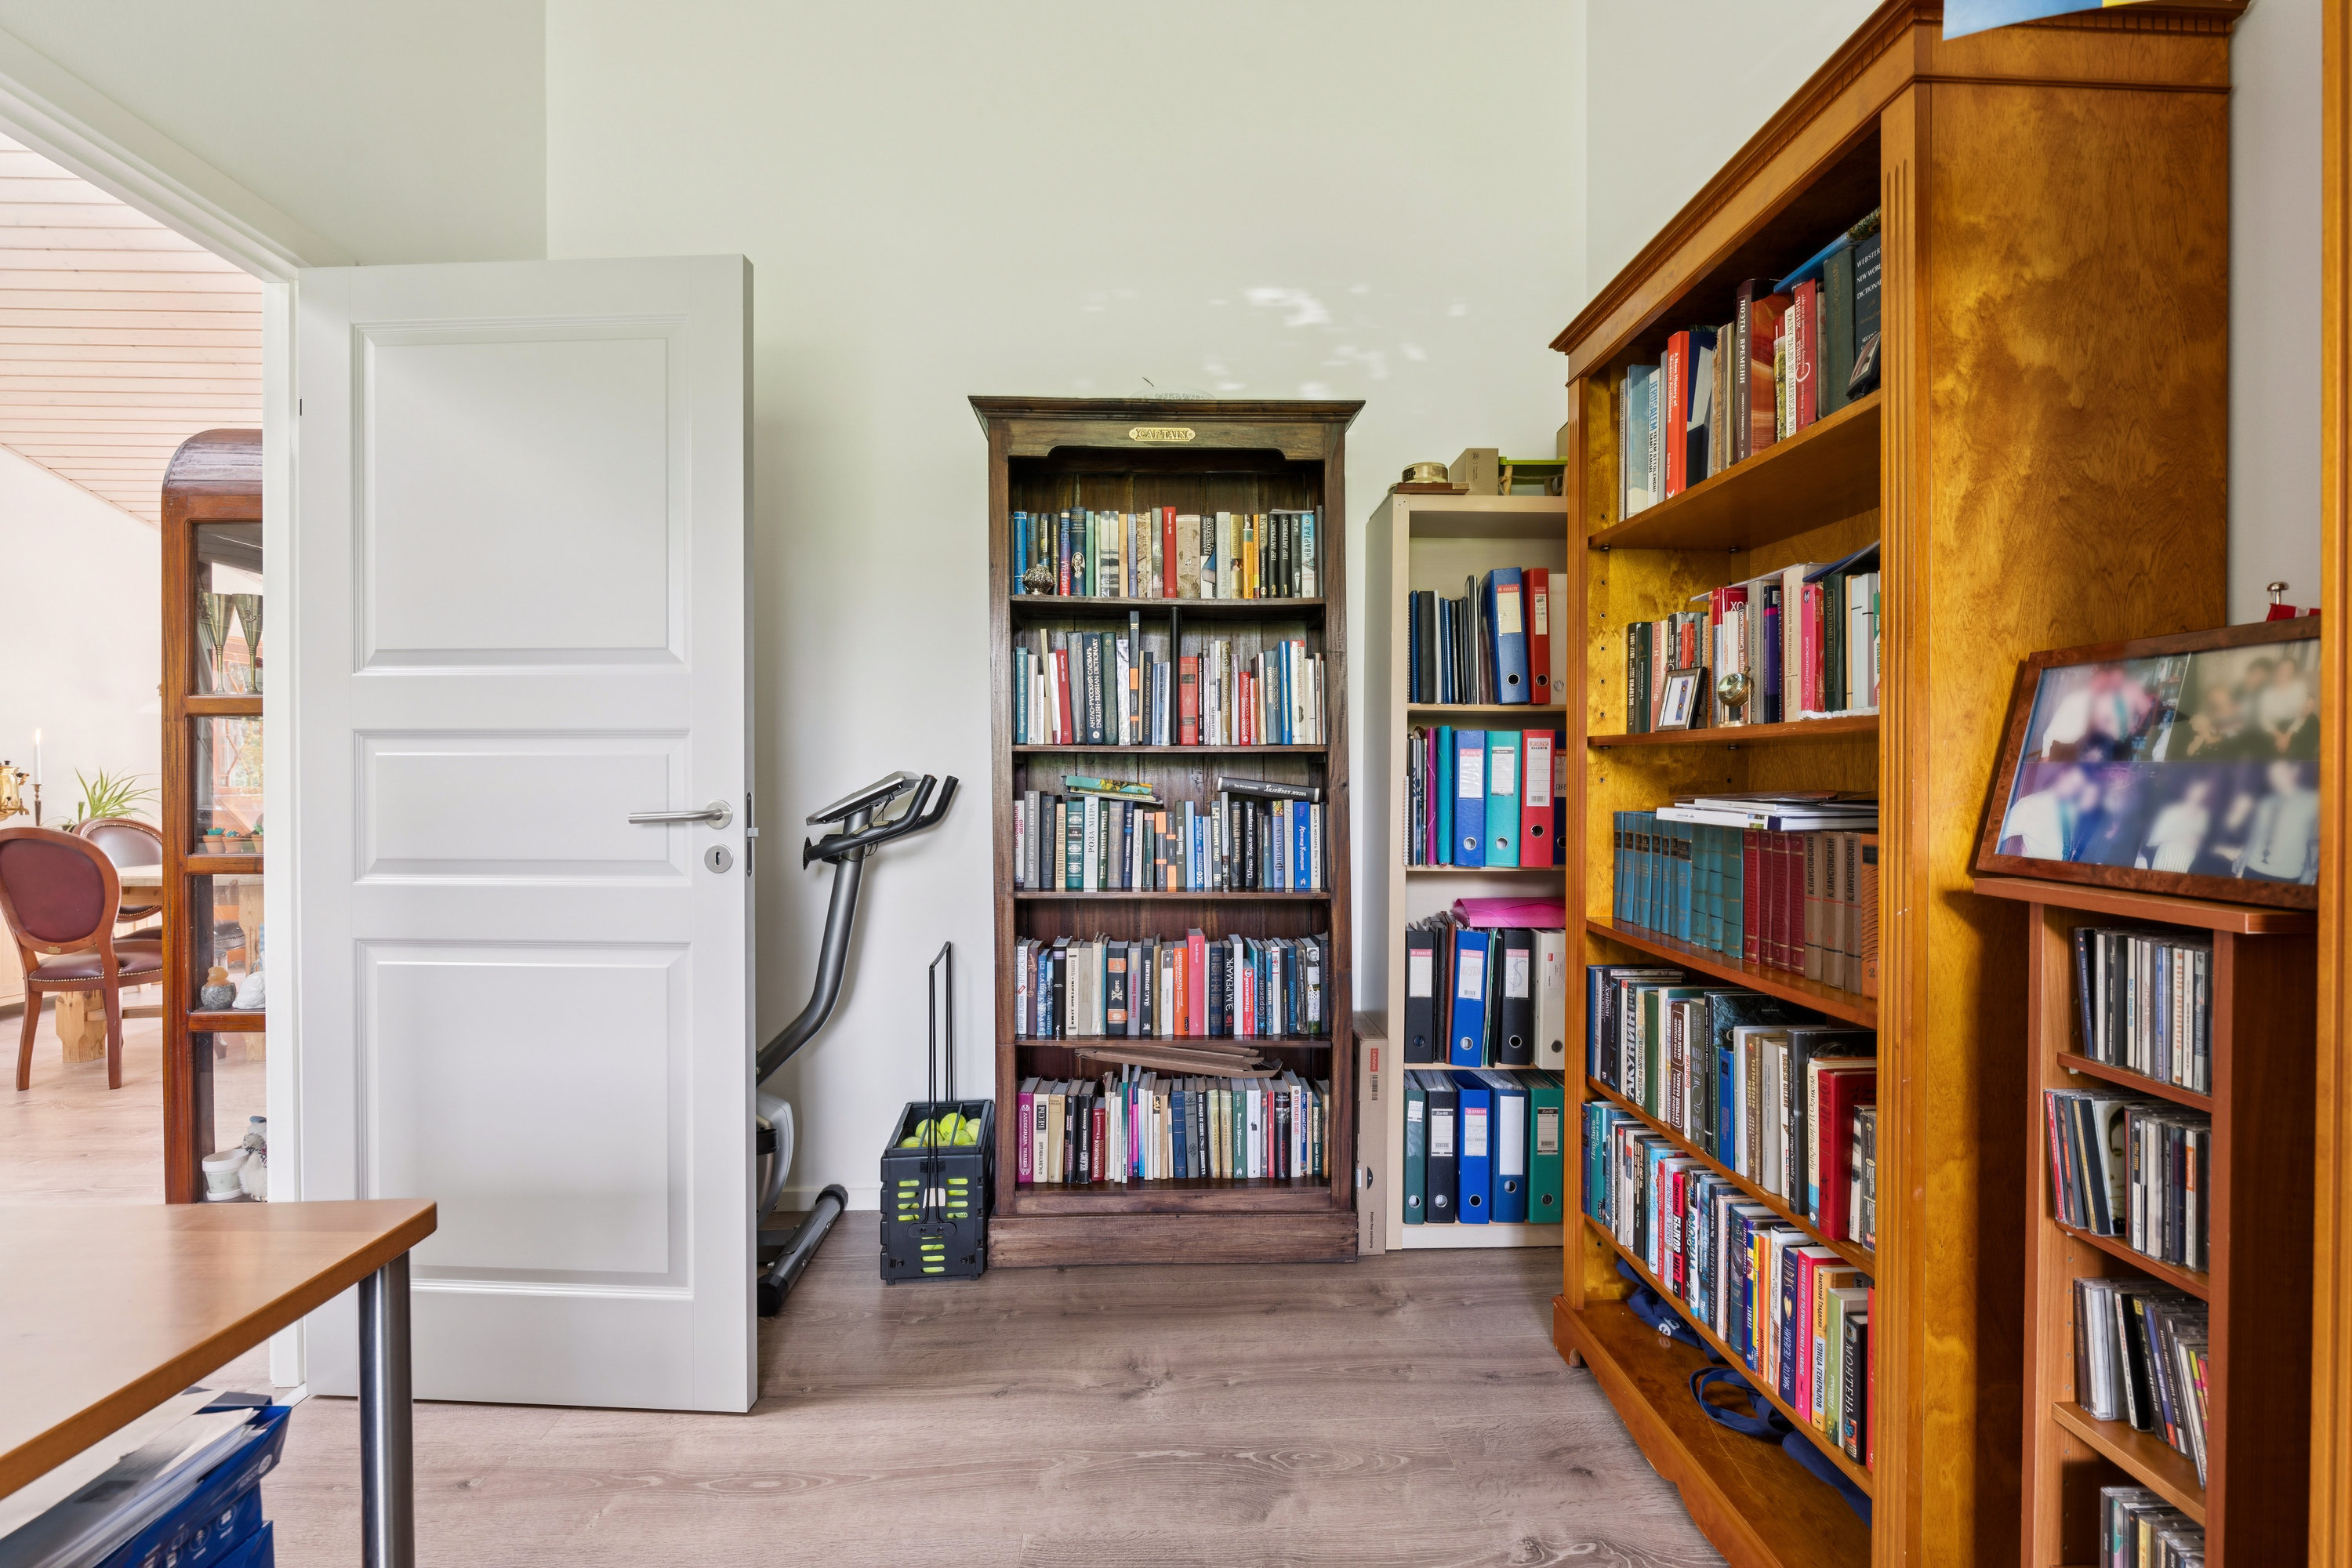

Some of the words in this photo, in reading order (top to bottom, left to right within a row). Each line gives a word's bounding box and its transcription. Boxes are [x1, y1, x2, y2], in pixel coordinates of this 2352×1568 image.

[1857, 273, 1867, 284] NEW
[1788, 364, 1794, 375] BY
[1650, 381, 1658, 430] JERUSALEM
[1138, 428, 1189, 440] CAPTAIN
[1302, 526, 1311, 557] КВАРТАЛ
[1826, 838, 1835, 898] К.ПАУСТОВСКИЙ
[1846, 840, 1855, 902] К.ПАУСТОВСКИЙ
[1018, 949, 1025, 958] 10
[1111, 979, 1123, 1001] Хармс
[1225, 957, 1234, 1011] Э.М.РЕМАРК
[1627, 1011, 1635, 1098] АКУНИН
[1666, 1208, 1671, 1218] ВО
[1845, 1341, 1854, 1414] МОНТЕНЬ
